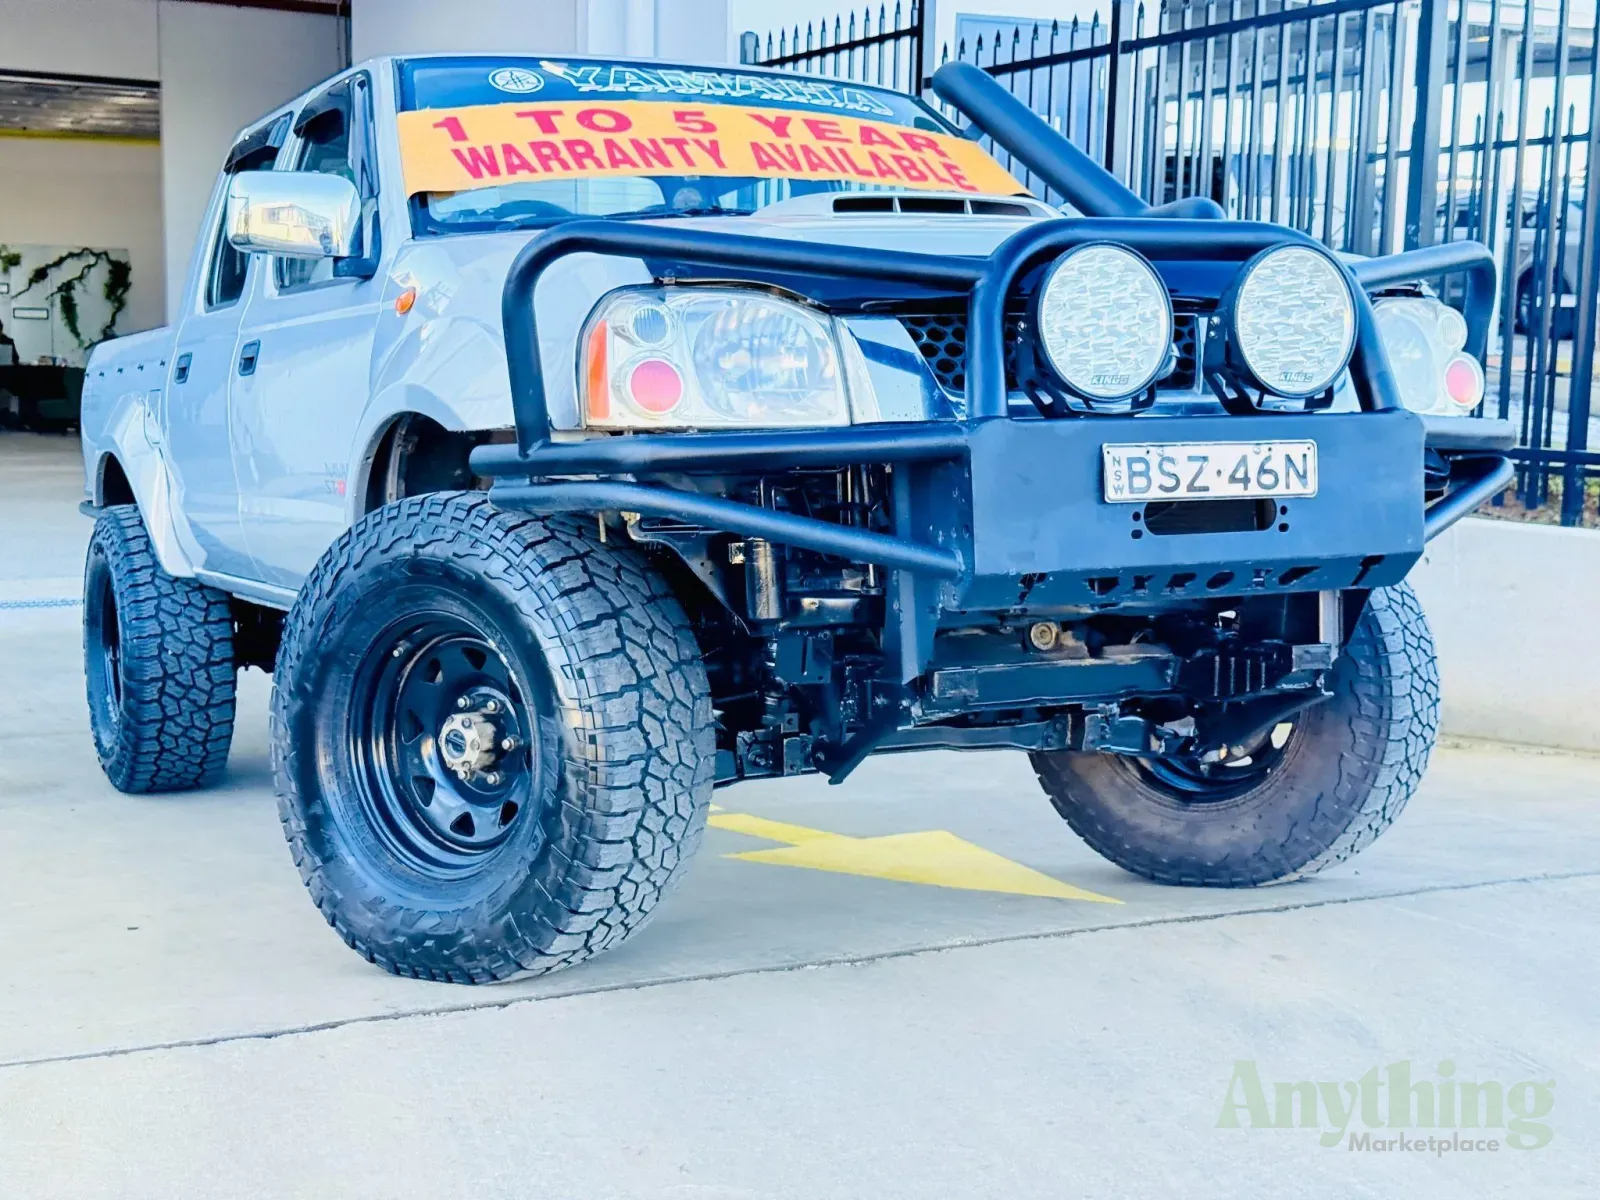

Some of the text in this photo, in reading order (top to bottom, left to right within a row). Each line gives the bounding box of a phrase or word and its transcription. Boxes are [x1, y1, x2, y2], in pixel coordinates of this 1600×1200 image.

[541, 60, 894, 116] YAMAHA
[432, 108, 953, 160] 1 TO 5 YEAR
[450, 137, 980, 192] WARRANTY AVAILABLE
[1090, 374, 1130, 386] KINGS
